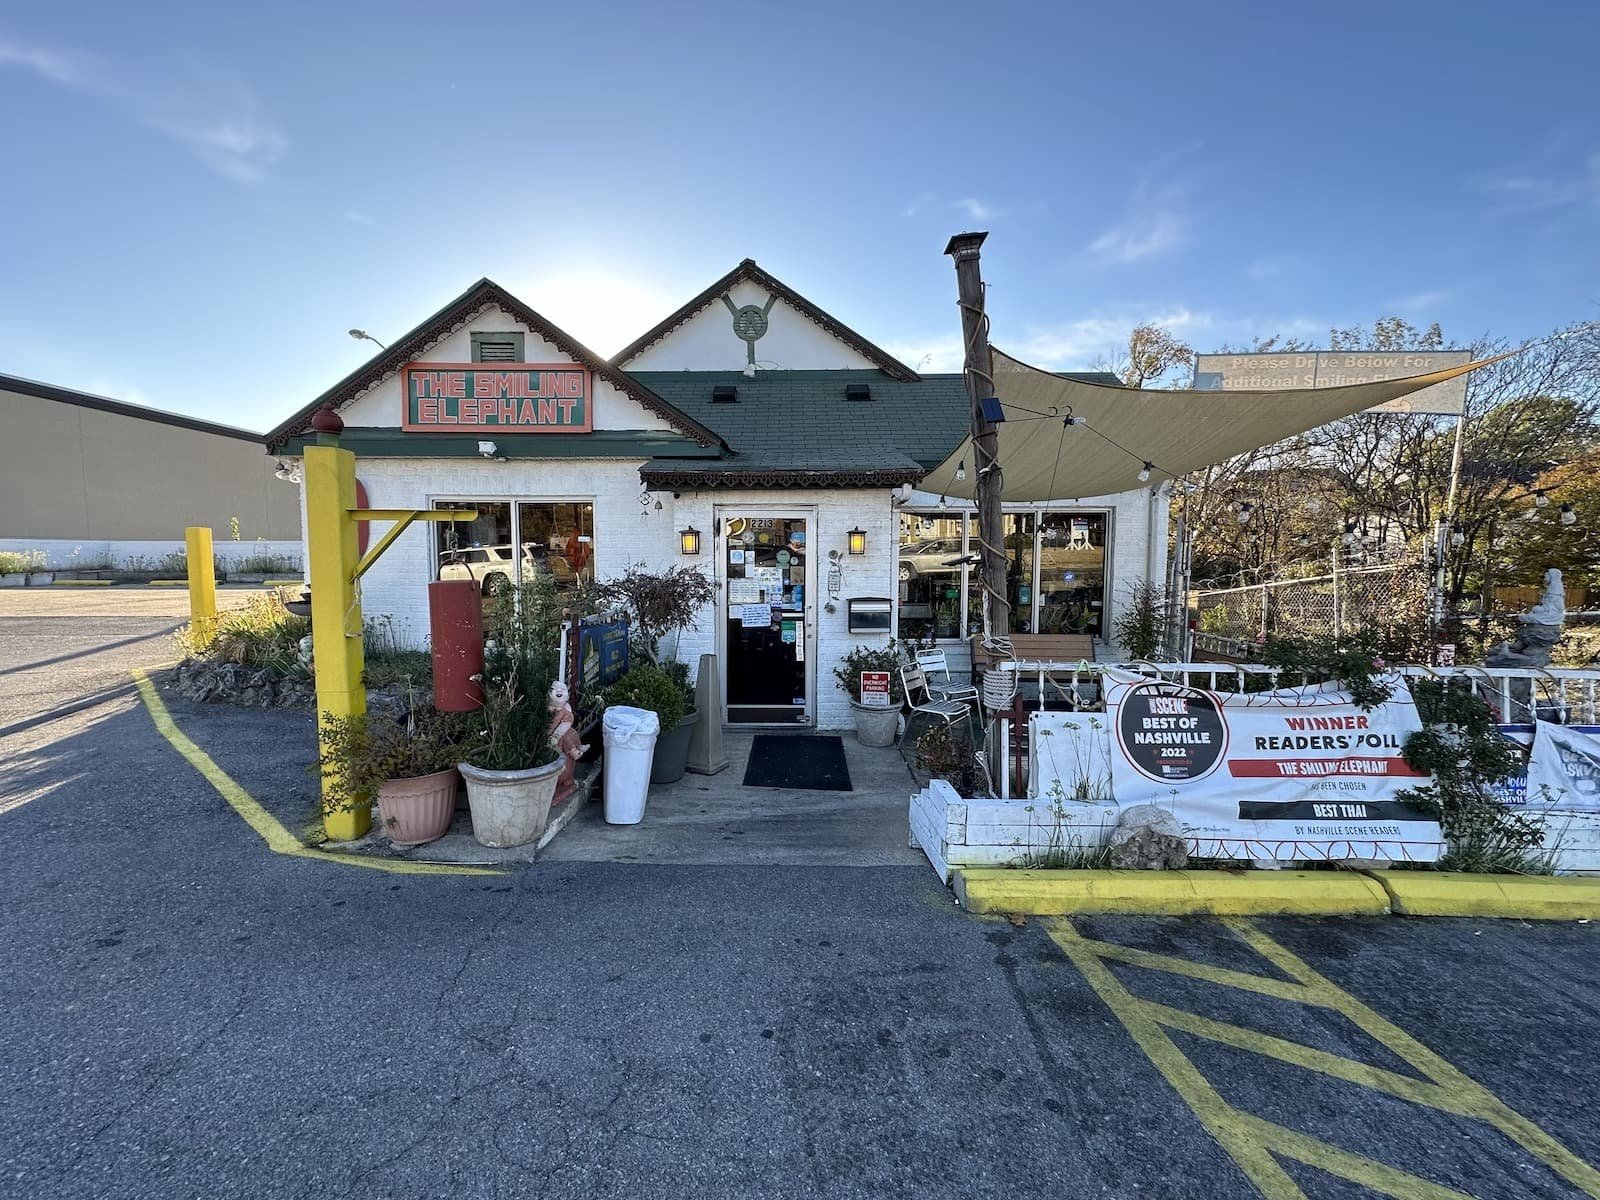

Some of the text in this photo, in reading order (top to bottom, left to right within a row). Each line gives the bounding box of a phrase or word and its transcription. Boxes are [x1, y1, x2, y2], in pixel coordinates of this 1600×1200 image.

[1231, 357, 1289, 369] Please
[1344, 355, 1398, 368] Below
[1403, 354, 1432, 367] For
[411, 372, 583, 398] THE SMILING
[1210, 374, 1297, 388] Additional
[418, 398, 577, 424] ELEPHANT
[751, 520, 773, 528] 2213
[1157, 697, 1188, 714] SCENE
[1142, 717, 1198, 729] BEST OF
[1285, 716, 1369, 731] WINNER
[1134, 732, 1211, 744] NASHVILLE
[1255, 734, 1400, 750] READERS' POLL
[1161, 747, 1187, 757] 2022
[1276, 762, 1298, 775] THE
[1339, 760, 1388, 774] ELEPHANT
[1339, 782, 1367, 790] CHOSEN
[1313, 804, 1368, 818] BEST THAI
[1294, 826, 1304, 835] BY
[1307, 826, 1341, 835] NASHVILLE
[1345, 826, 1368, 836] SCENE
